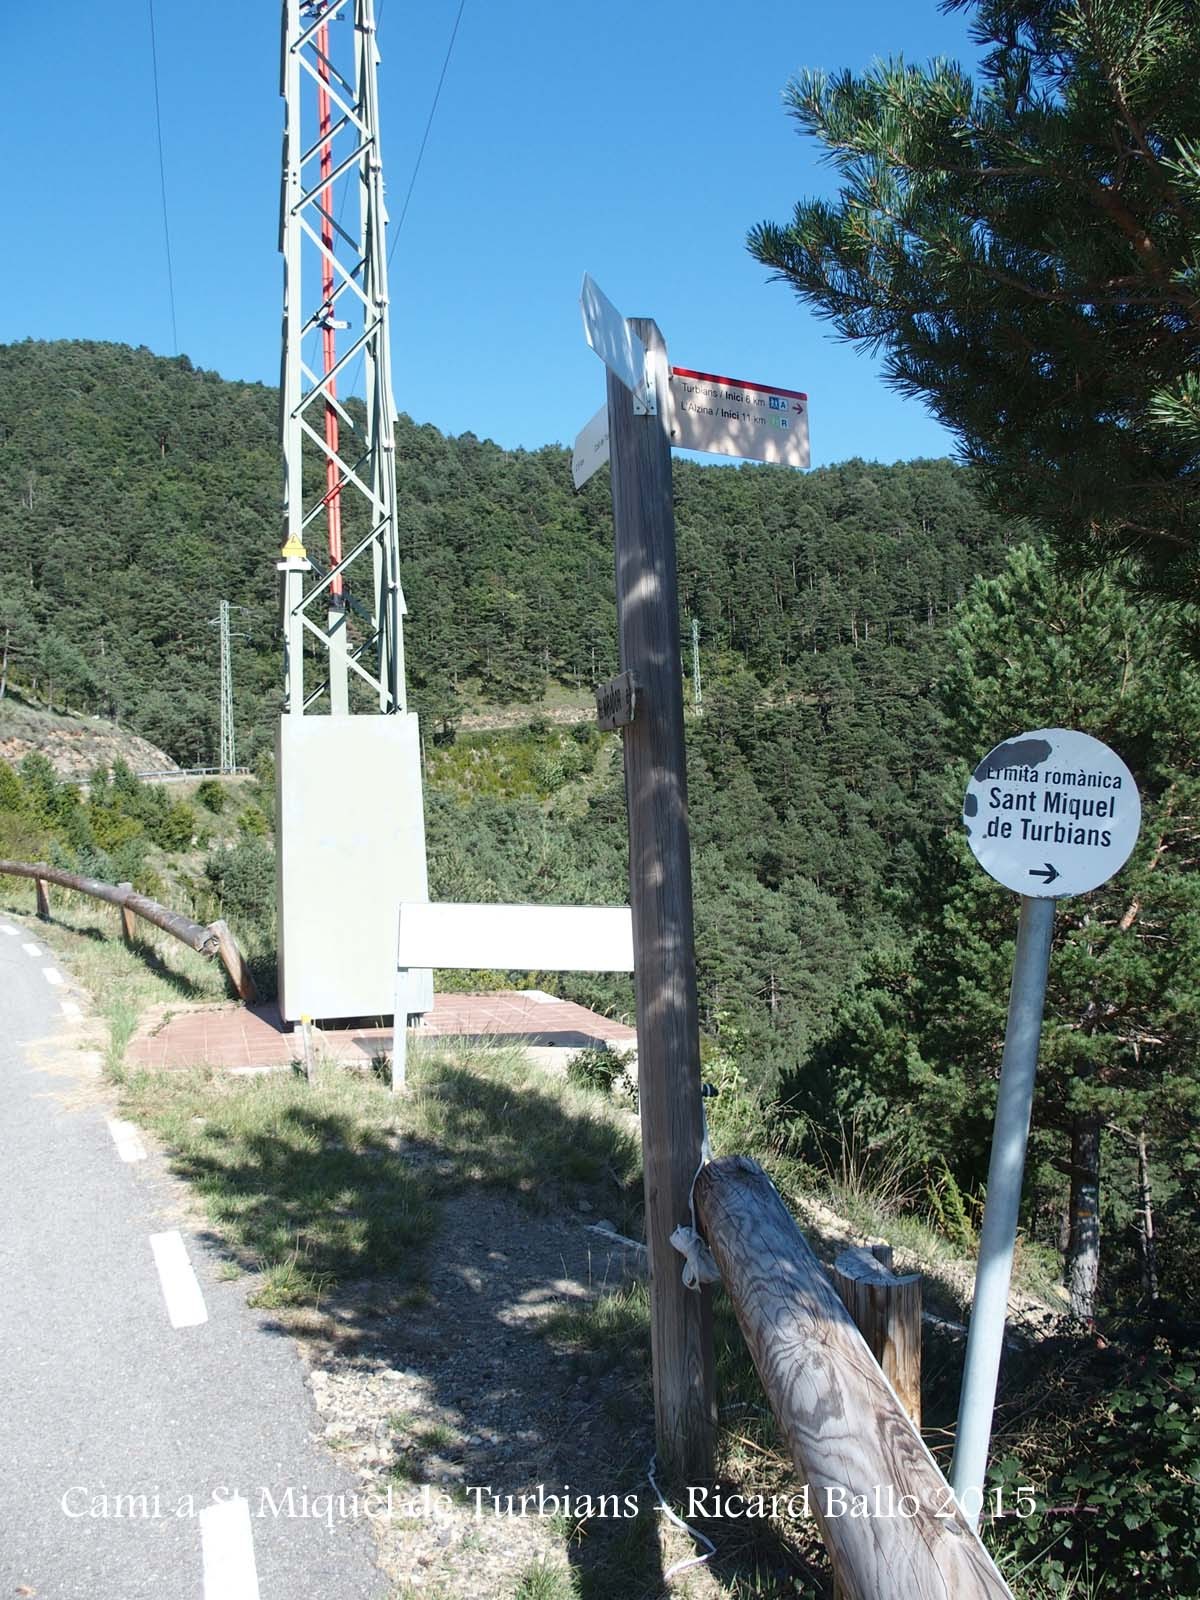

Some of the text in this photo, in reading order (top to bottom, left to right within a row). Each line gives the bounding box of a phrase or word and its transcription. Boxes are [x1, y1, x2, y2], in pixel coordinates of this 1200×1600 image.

[682, 383, 718, 397] Turbians
[725, 391, 744, 403] Inici
[753, 398, 766, 407] km
[681, 400, 714, 415] L'Alzina
[721, 408, 740, 420] Inici
[742, 413, 751, 421] 11
[754, 415, 766, 425] km
[987, 766, 1122, 789] Ermita romànica
[989, 787, 1115, 820] Sant Miquel
[987, 816, 1111, 847] de Turbians
